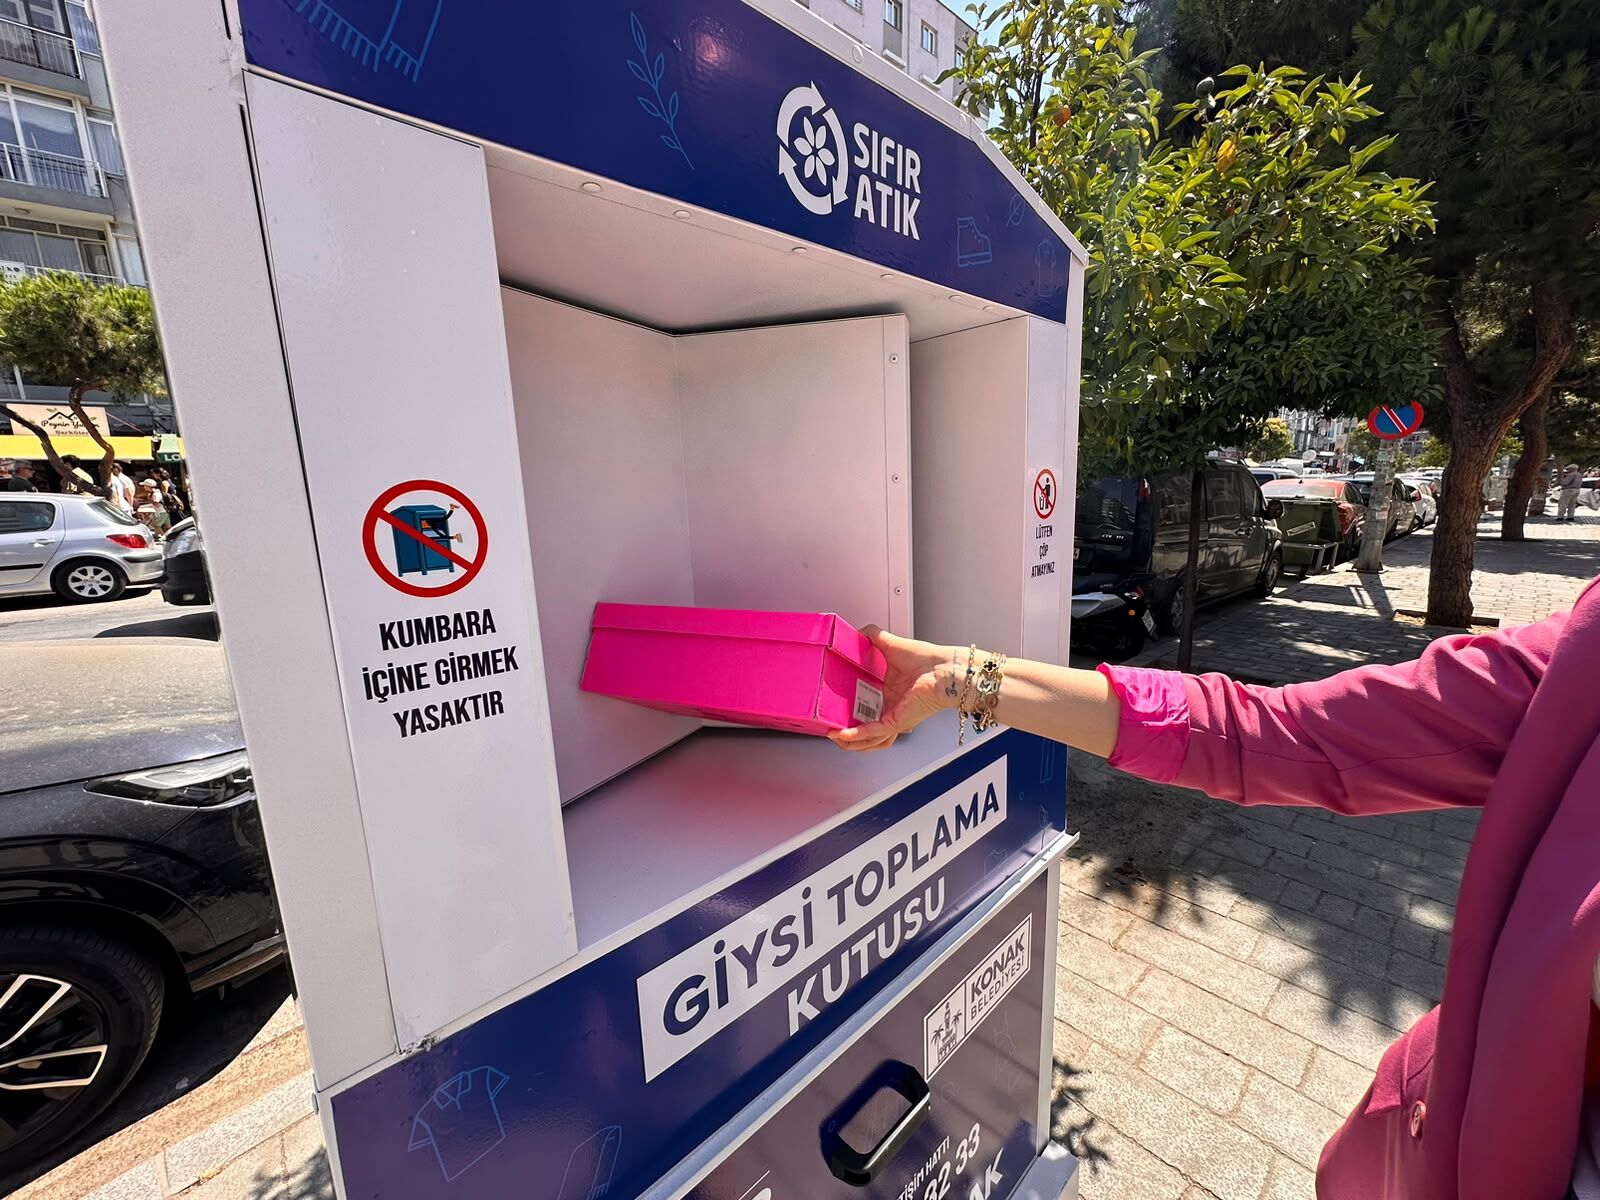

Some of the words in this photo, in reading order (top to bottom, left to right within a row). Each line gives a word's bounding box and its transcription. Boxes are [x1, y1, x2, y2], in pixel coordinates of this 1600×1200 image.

[853, 122, 921, 194] SIFIR
[854, 173, 921, 241] ATIK
[1035, 523, 1053, 539] LÜTFEN
[1039, 542, 1049, 560] ÇÖP
[378, 608, 497, 651] KUMBARA
[361, 662, 431, 704] İÇİNE
[434, 645, 520, 686] GİRMEK
[392, 690, 505, 739] YASAKTIR
[663, 887, 813, 1036] GİYSİ
[827, 782, 1000, 926] TOPLAMA
[786, 877, 947, 1037] KUTUSU
[970, 931, 1025, 1004] KONAK
[970, 951, 1025, 1021] BELEDİYESİ
[925, 1135, 950, 1177] HATTI
[955, 1122, 980, 1175] 33
